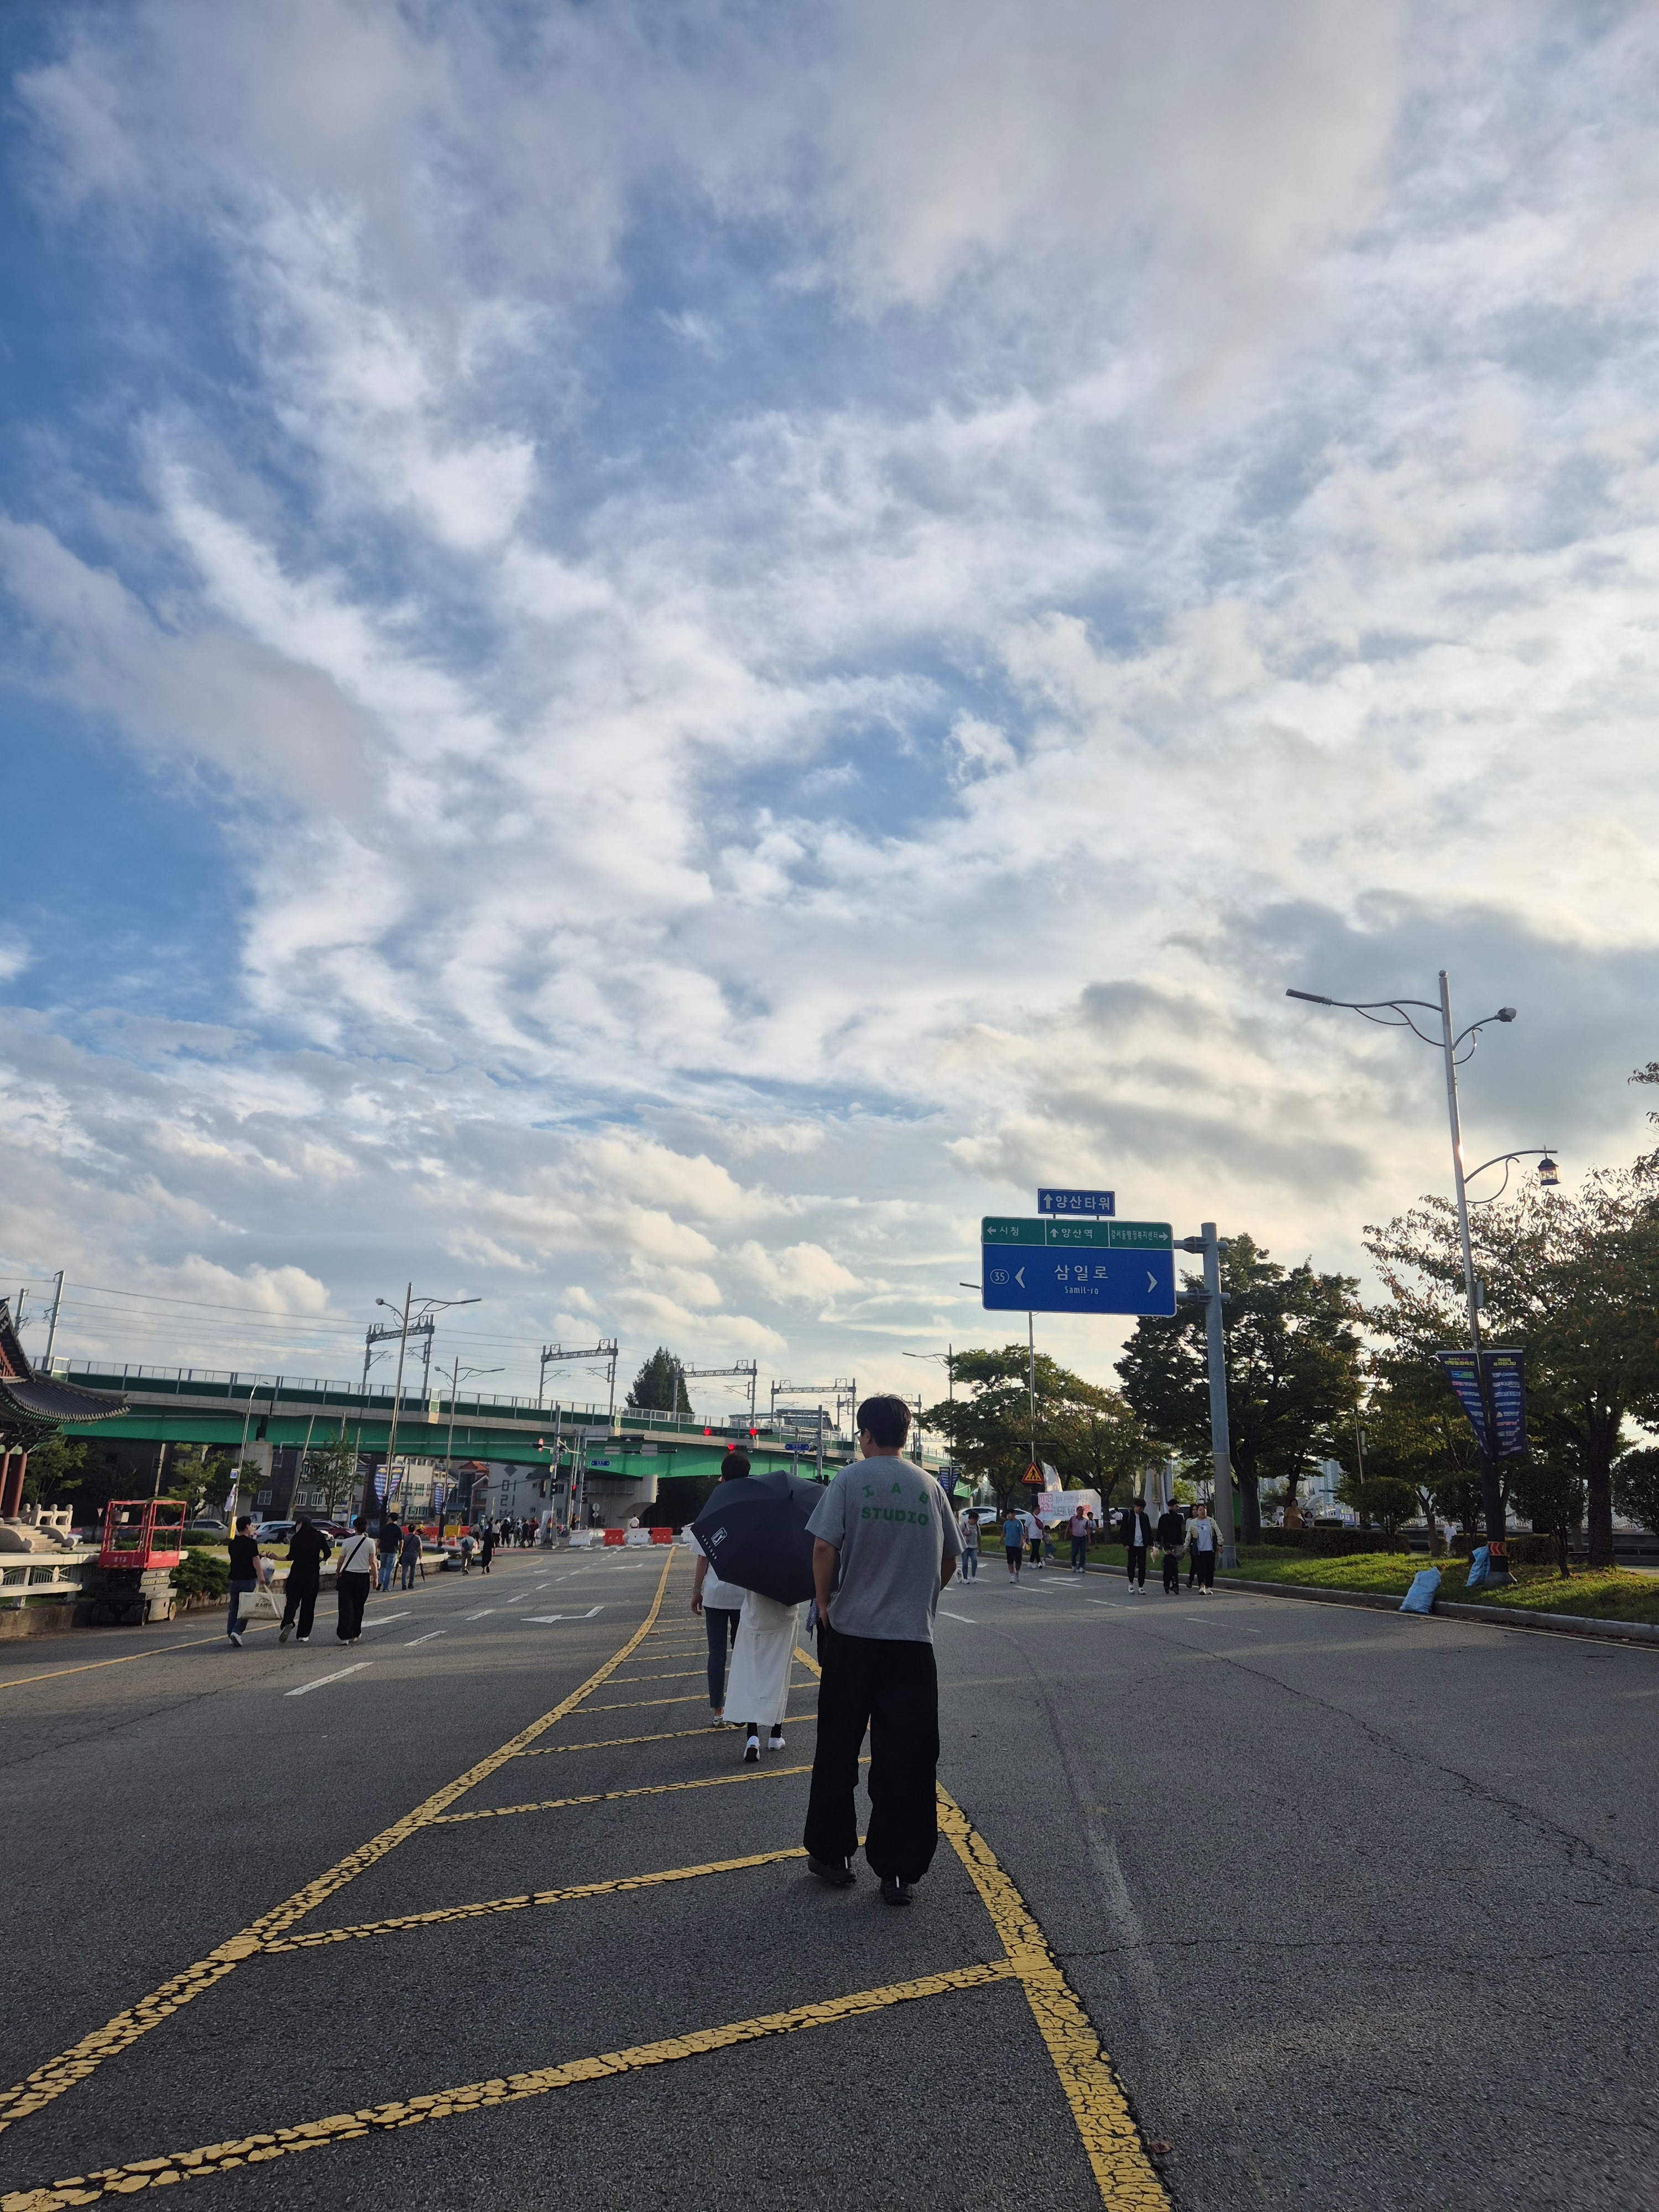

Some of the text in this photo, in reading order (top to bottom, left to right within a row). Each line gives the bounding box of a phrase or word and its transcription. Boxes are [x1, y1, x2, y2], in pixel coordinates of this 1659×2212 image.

[1056, 1195, 1110, 1211] 양산타워
[1000, 1226, 1020, 1236] 시청
[1061, 1228, 1093, 1239] 양산역
[1111, 1230, 1158, 1240] 강서동행정복지센터
[994, 1272, 1005, 1281] 35
[1054, 1265, 1108, 1282] 삼일로
[1065, 1286, 1099, 1295] Samil-ro
[862, 1507, 928, 1526] STUDIO
